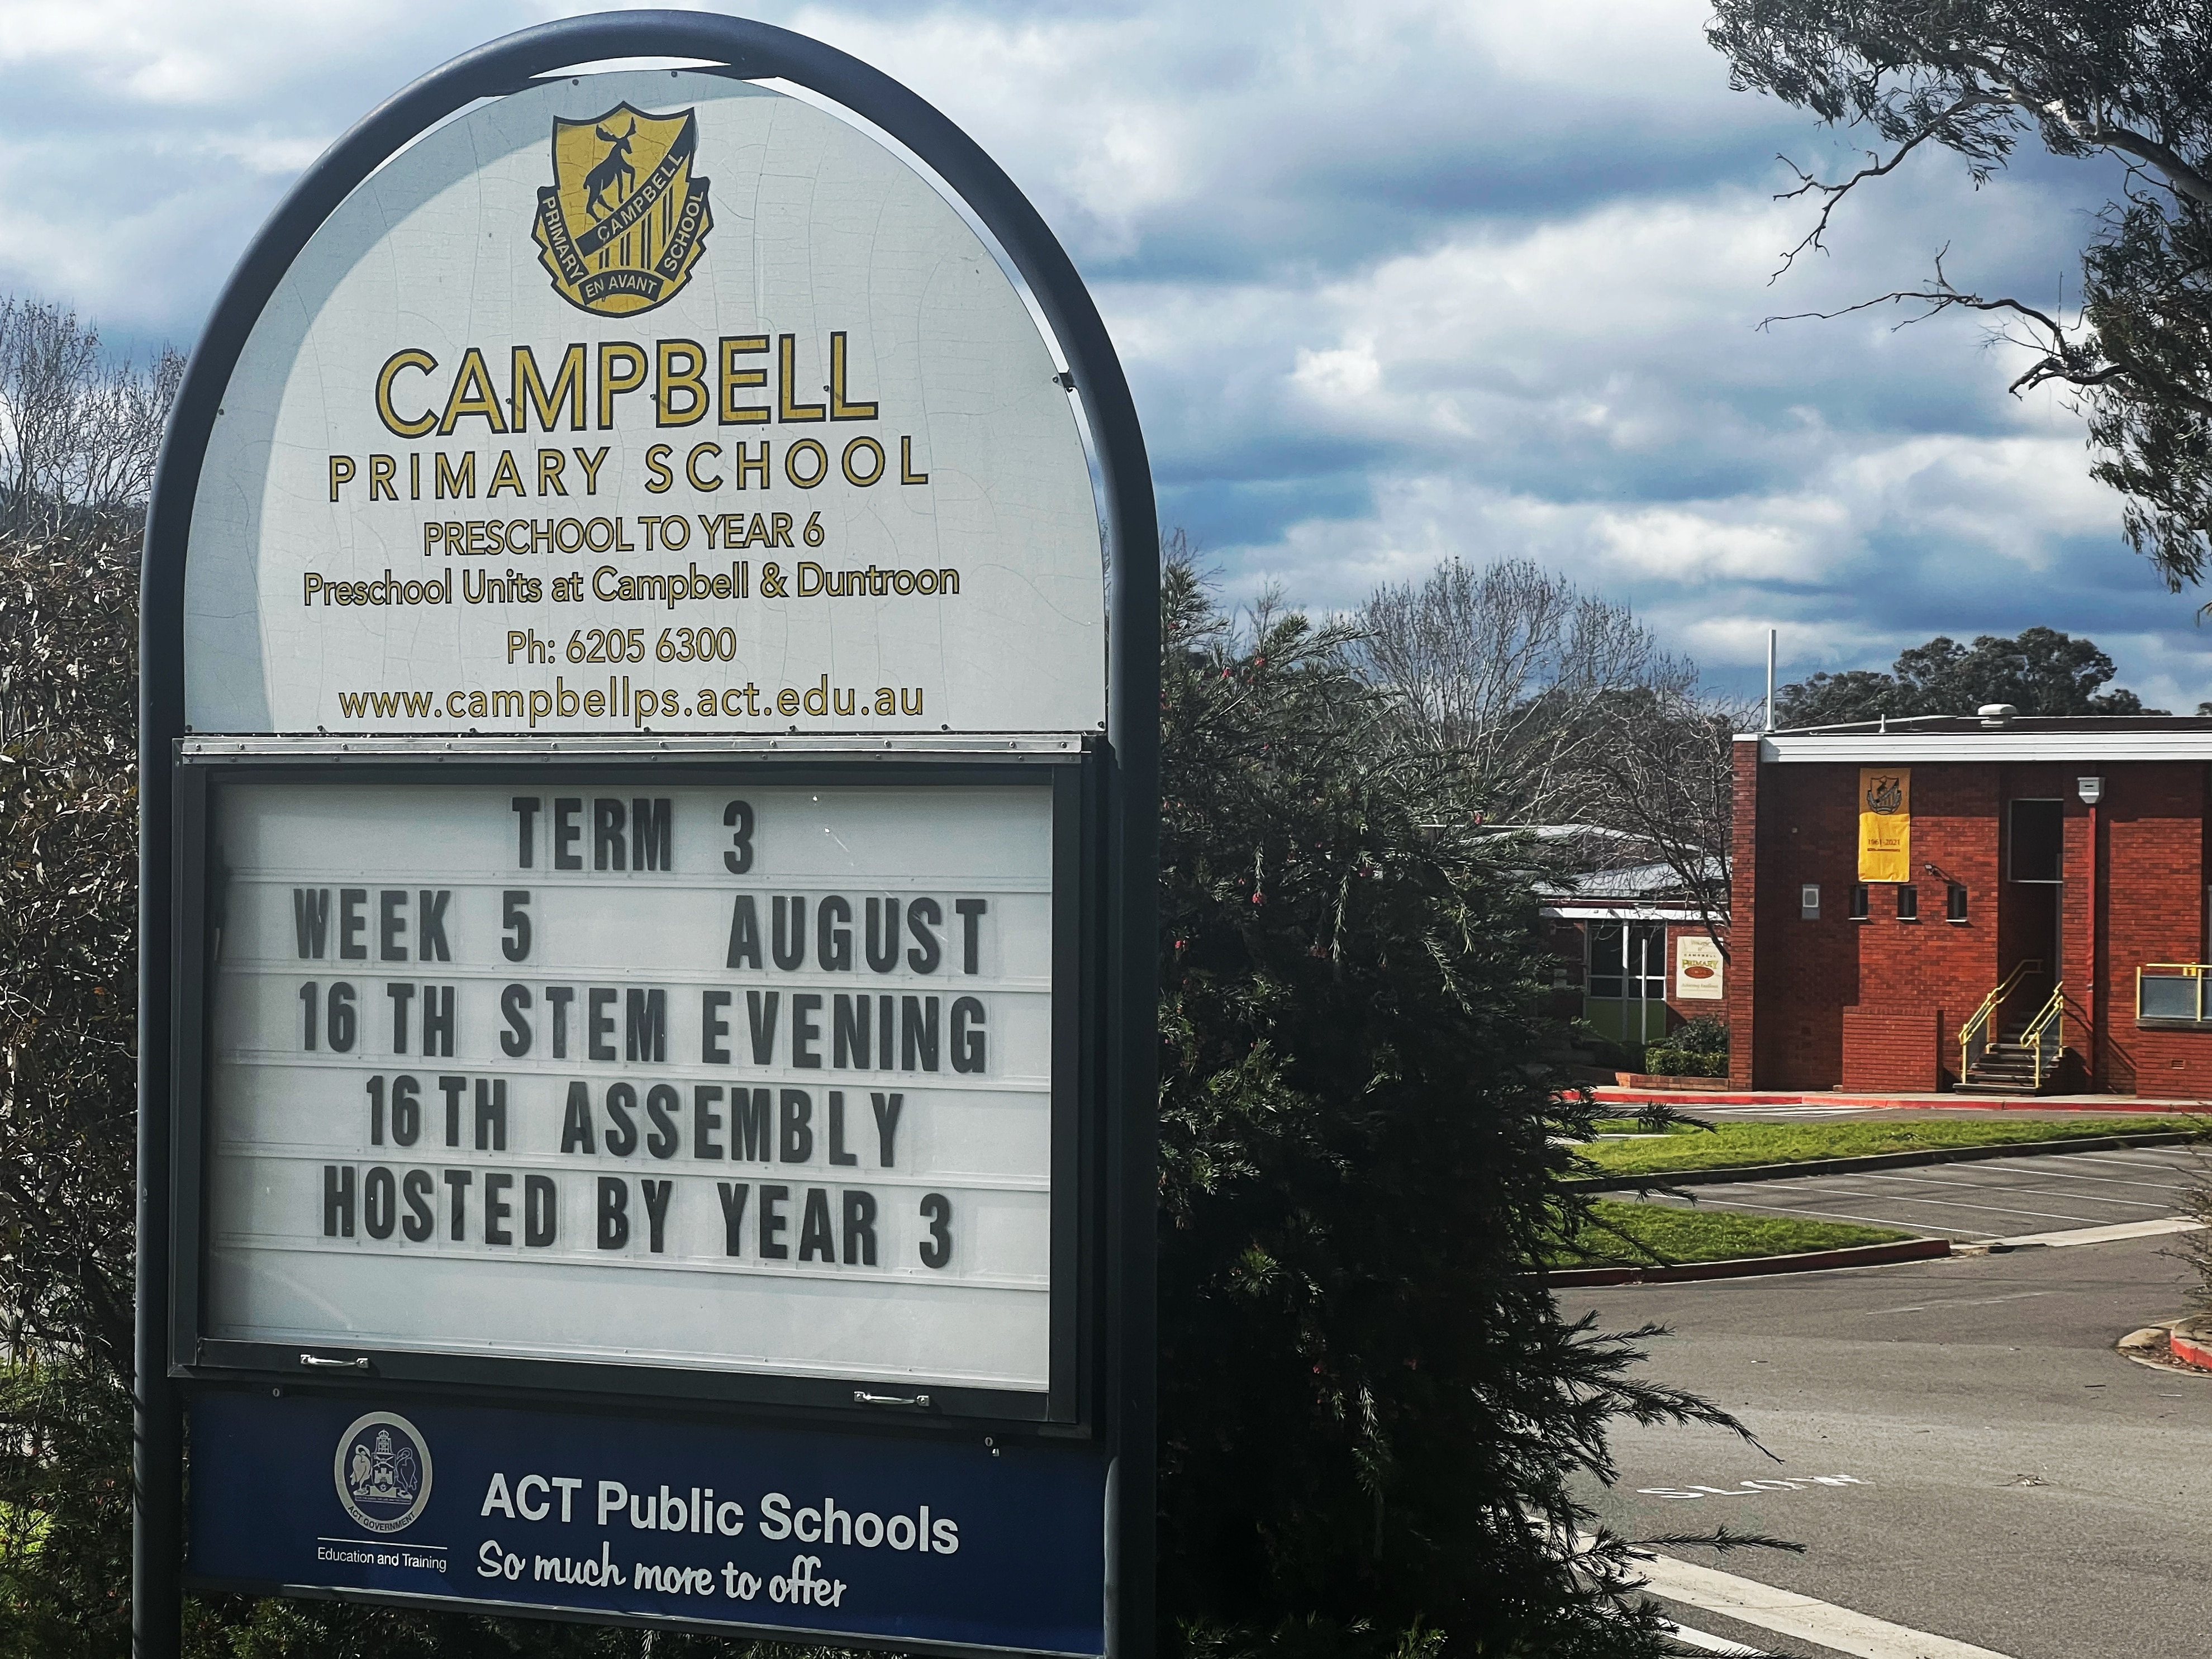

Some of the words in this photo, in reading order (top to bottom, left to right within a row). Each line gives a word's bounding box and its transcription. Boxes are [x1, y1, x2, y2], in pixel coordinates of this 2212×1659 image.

[597, 154, 683, 242] CAMPBELL
[664, 191, 704, 272] SCHOOL
[543, 196, 584, 280] PRIMARY
[586, 282, 604, 298] EN
[608, 275, 657, 294] AVANT
[376, 331, 879, 439] CAMPBELL
[329, 447, 610, 501] PRIMARY
[645, 435, 929, 493] SCHOOL
[424, 517, 635, 557] PRESCHOOL
[638, 516, 686, 552] TO
[700, 513, 793, 550] YEAR
[802, 511, 825, 546] 6
[305, 568, 452, 607] Preschool
[462, 568, 543, 605] Units
[552, 572, 583, 602] at
[592, 562, 749, 609] Campbell
[760, 564, 789, 598] &
[797, 563, 959, 598] Duntroon
[506, 631, 556, 664] Ph:
[566, 629, 645, 663] 6205
[656, 627, 736, 662] 6300
[339, 674, 924, 728] www.campbellps.act.edu.au
[512, 797, 672, 873] TERM
[723, 800, 754, 874] 3
[293, 888, 451, 962] WEEK
[501, 890, 531, 963] 5
[726, 895, 987, 974] AUGUST
[1682, 959, 1719, 969] PRIMARY
[299, 982, 356, 1054] 16
[386, 983, 456, 1057] TH
[500, 984, 668, 1063] STEM
[702, 991, 987, 1073] EVENING
[366, 1075, 507, 1151] 16TH
[560, 1081, 905, 1168] ASSEMBLY
[324, 1165, 556, 1248] HOSTED
[597, 1176, 673, 1254] BY
[716, 1182, 877, 1266] YEAR
[919, 1193, 952, 1269] 3
[348, 1505, 363, 1520] ACT
[363, 1511, 415, 1531] GOVERNMENT
[481, 1472, 582, 1524] ACT
[597, 1480, 745, 1537] Public
[759, 1491, 960, 1555] Schools
[318, 1547, 374, 1563] Education
[377, 1553, 399, 1566] and
[402, 1553, 446, 1572] Training
[476, 1539, 524, 1580] So
[534, 1540, 626, 1587] much
[635, 1561, 715, 1596] more
[722, 1561, 760, 1601] to
[768, 1555, 847, 1607] offer
